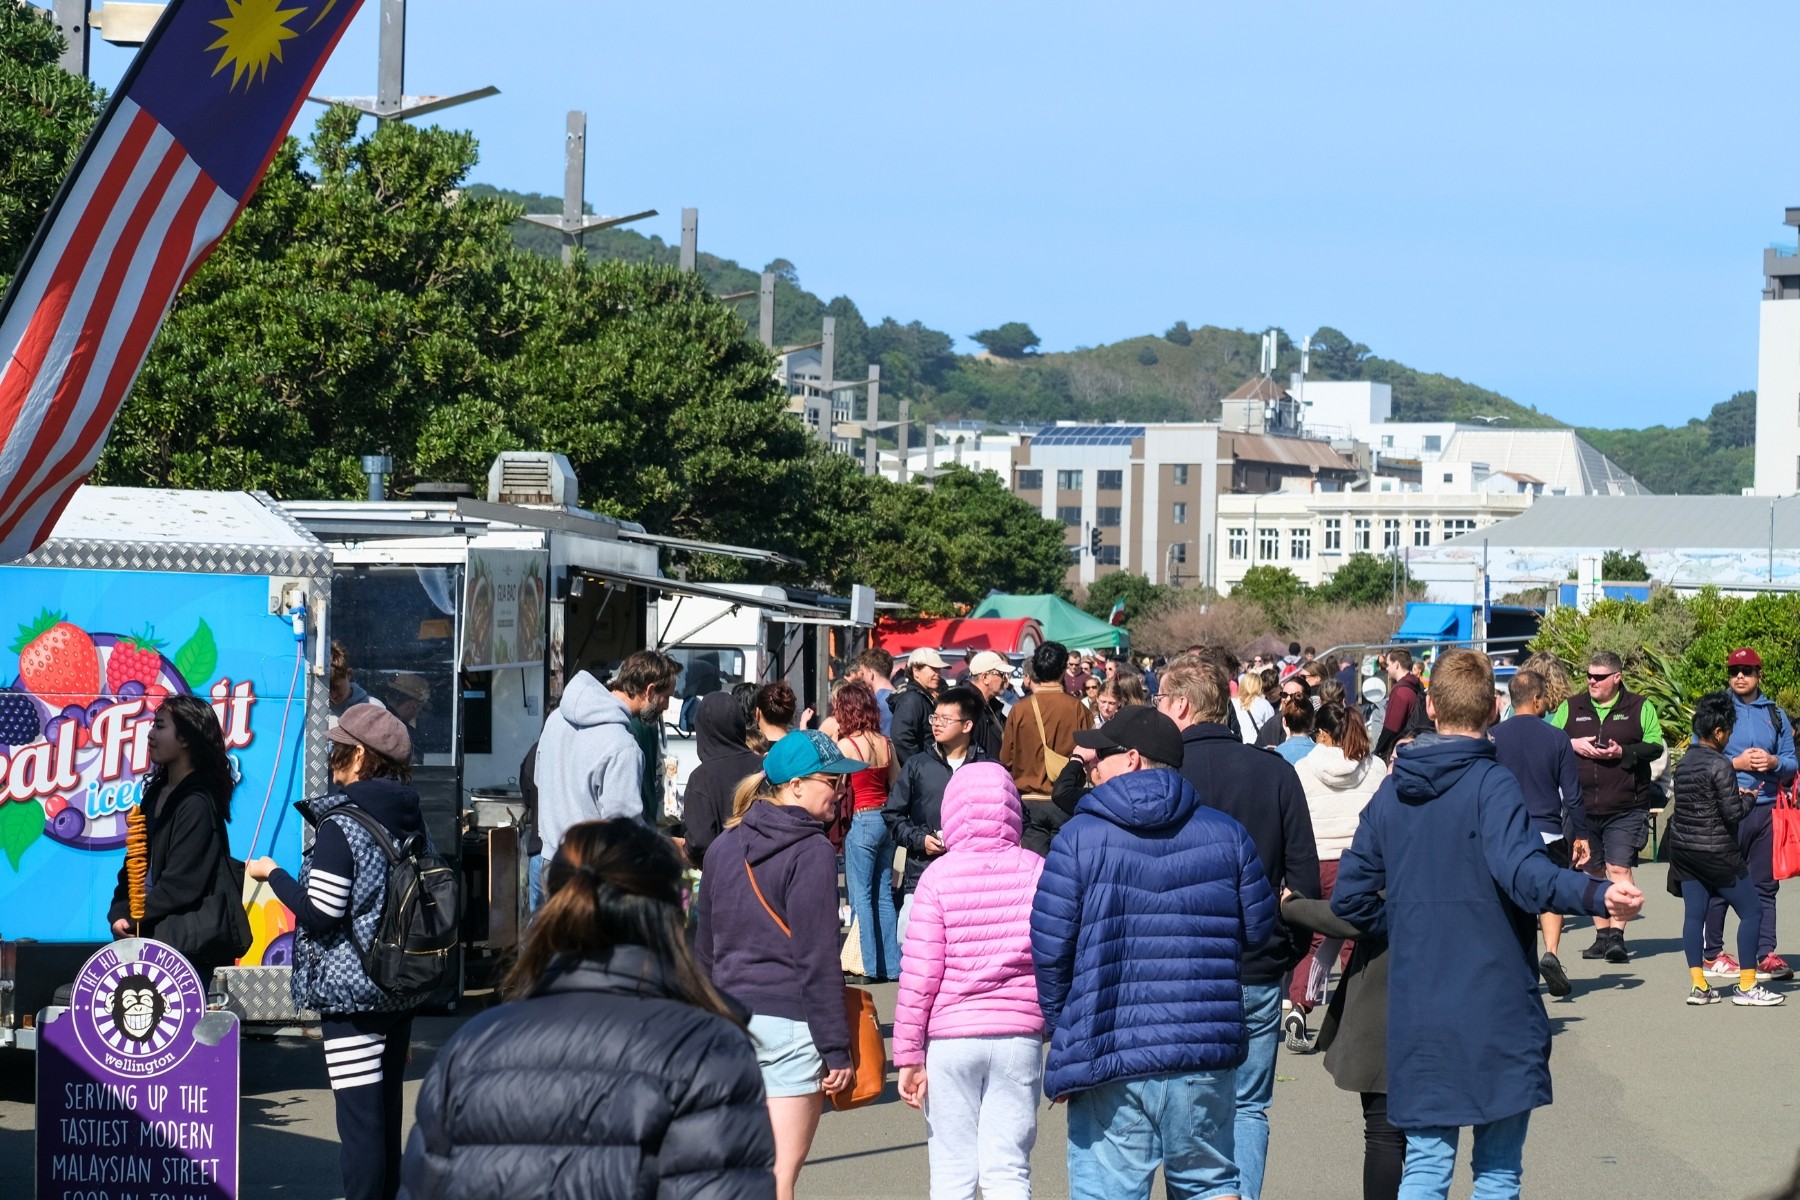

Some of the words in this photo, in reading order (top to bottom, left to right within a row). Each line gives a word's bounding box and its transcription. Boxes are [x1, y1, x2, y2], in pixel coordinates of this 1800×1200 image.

[91, 676, 256, 781] Frit
[79, 970, 101, 993] THE
[98, 944, 149, 971] HUY
[155, 949, 198, 996] MONKEY
[105, 1052, 176, 1075] wellington
[65, 1082, 137, 1111] SERVING
[148, 1084, 169, 1113] UP
[179, 1085, 208, 1114] THE
[60, 1117, 129, 1148] TASTIEST
[140, 1120, 213, 1149] MODERN
[52, 1154, 151, 1183] MALAYSIAN
[162, 1157, 220, 1186] STREET
